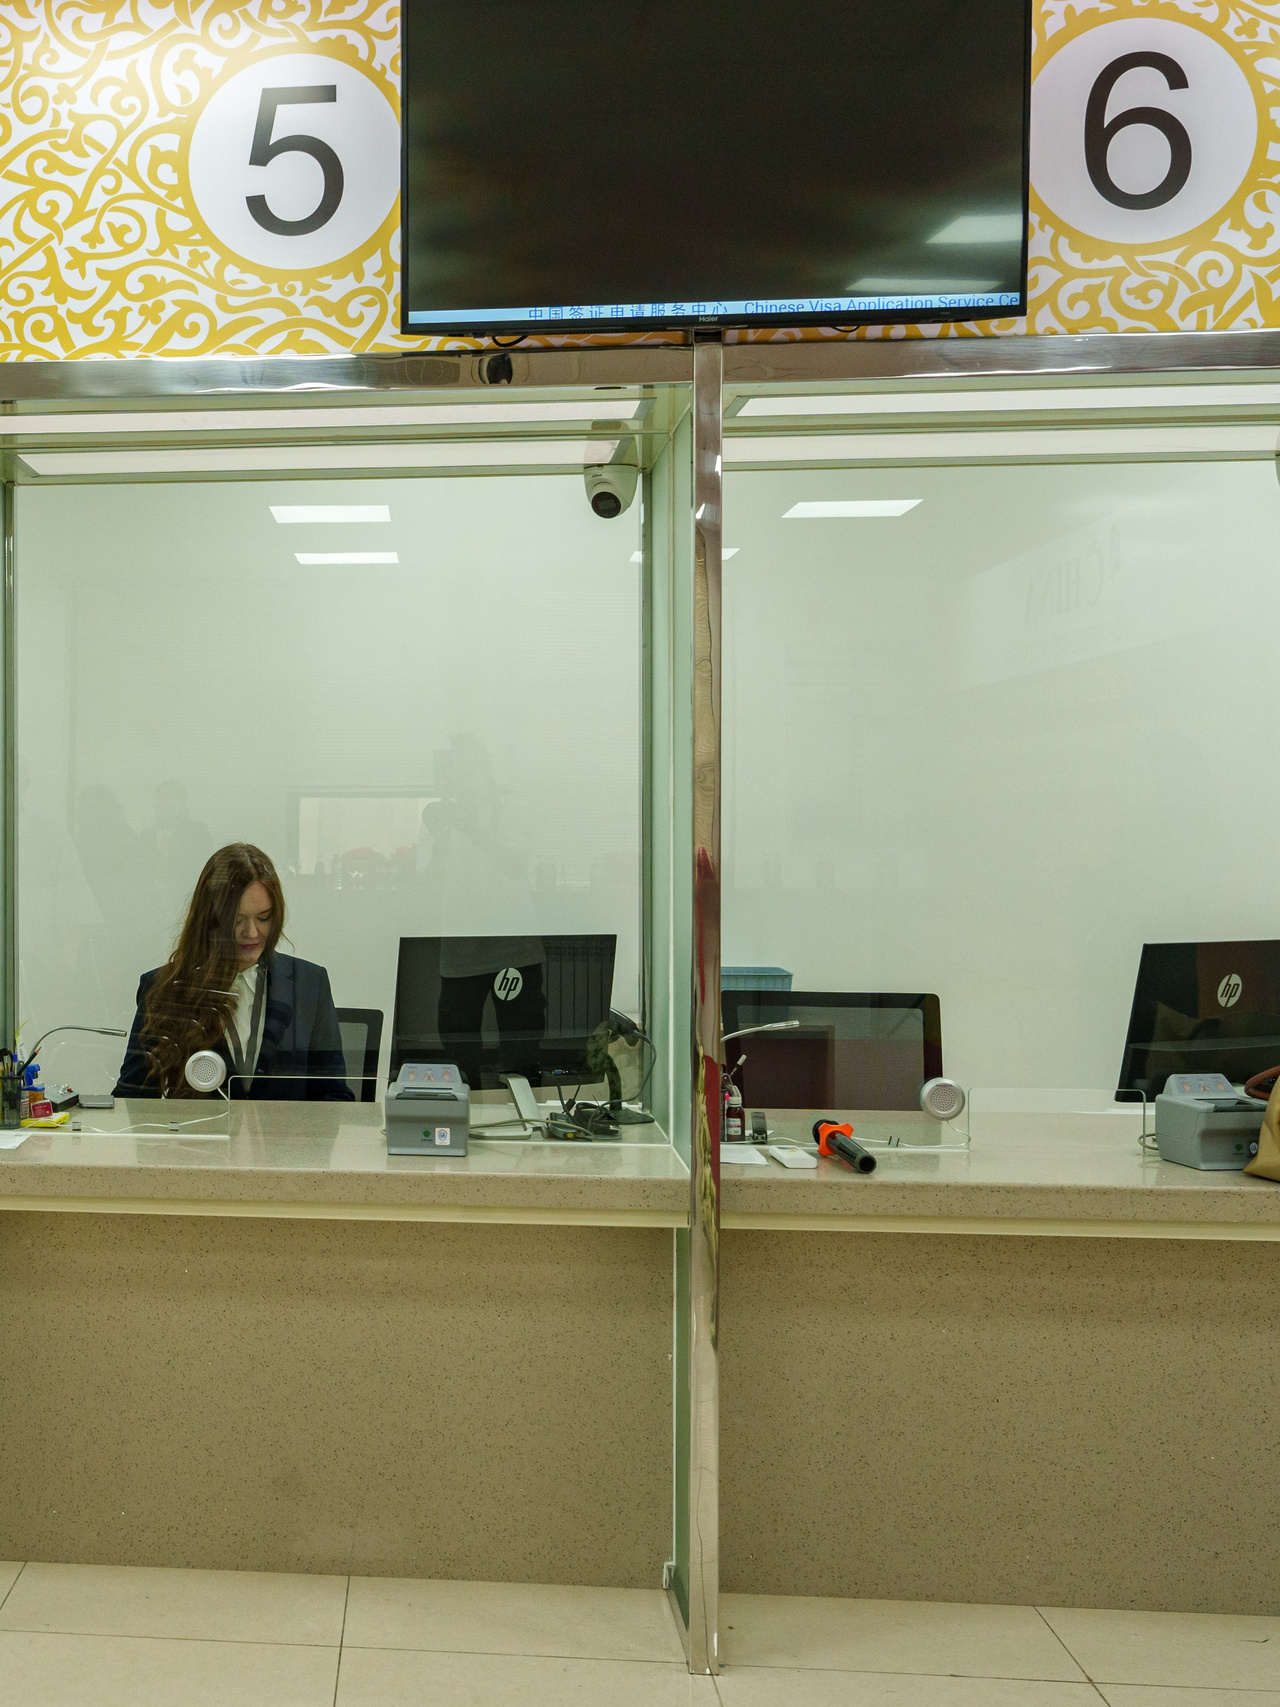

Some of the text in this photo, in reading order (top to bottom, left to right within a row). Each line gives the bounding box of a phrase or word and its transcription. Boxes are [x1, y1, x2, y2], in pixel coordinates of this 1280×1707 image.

[1084, 50, 1192, 210] 6
[245, 84, 344, 236] 5
[744, 294, 1018, 314] Chinese Visa Application Service Ce
[496, 968, 521, 1001] hp
[1219, 974, 1240, 1007] hp
